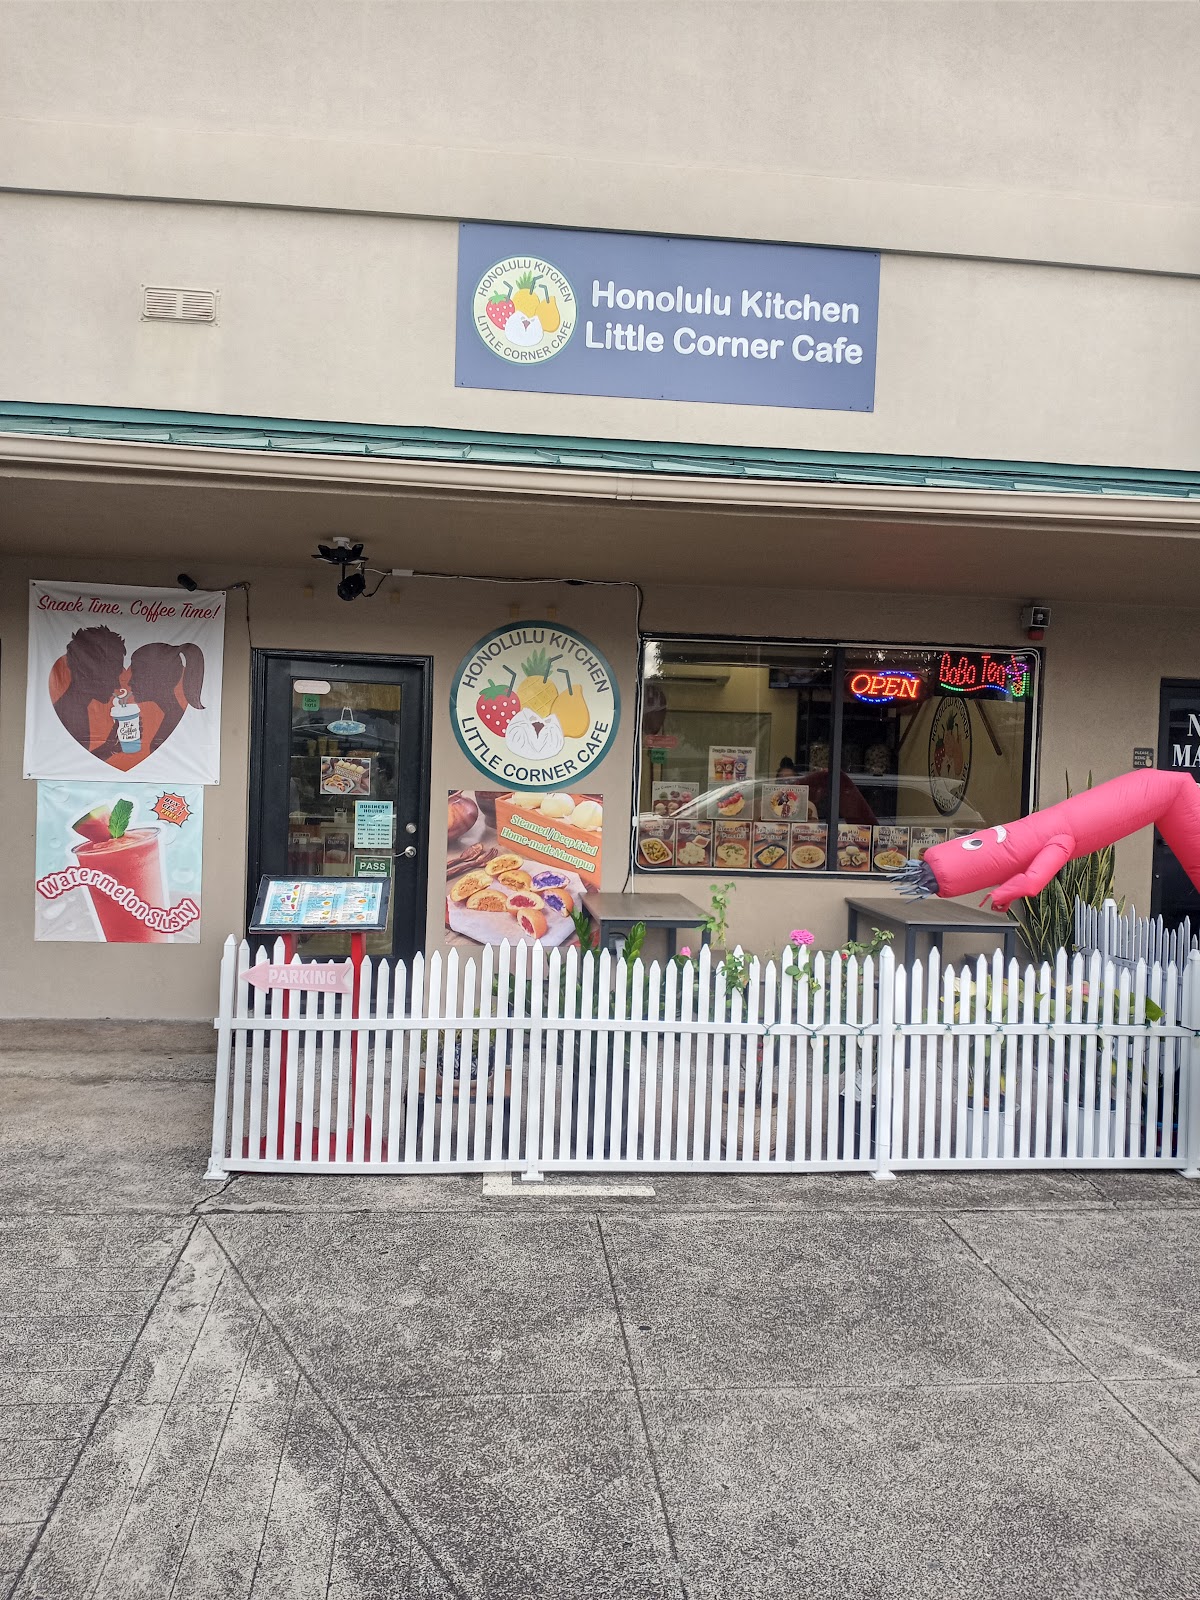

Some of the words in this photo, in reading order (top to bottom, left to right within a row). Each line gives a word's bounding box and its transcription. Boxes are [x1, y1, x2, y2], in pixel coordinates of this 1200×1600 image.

[478, 259, 531, 298] HONOLULU
[534, 261, 574, 303] KITCHEN
[592, 280, 731, 316] Honolulu
[741, 290, 860, 324] Kitchen
[477, 314, 503, 353] LITTLE
[503, 345, 552, 361] CORNER
[551, 320, 572, 350] CAFE
[585, 321, 664, 353] Little
[673, 327, 784, 361] Corner
[791, 335, 864, 365] Cafe
[37, 595, 84, 612] Snack
[130, 600, 177, 623] Coffee
[180, 602, 221, 620] Time!
[462, 630, 545, 689] HONOLULU
[549, 632, 610, 693] KITCHEN
[980, 655, 1006, 687] Tea
[850, 673, 920, 699] OPEN
[461, 716, 503, 770] LITTLE
[503, 759, 578, 783] CORNER
[578, 720, 609, 764] CAFE
[160, 808, 179, 820] FREE
[162, 803, 177, 812] GET
[164, 797, 181, 807] BUY
[360, 862, 386, 870] PASS
[501, 827, 555, 857] Home-made
[553, 848, 596, 873] Manapua
[37, 866, 149, 920] Watermelon
[145, 898, 200, 933] Slushy
[268, 967, 337, 986] PARKING
